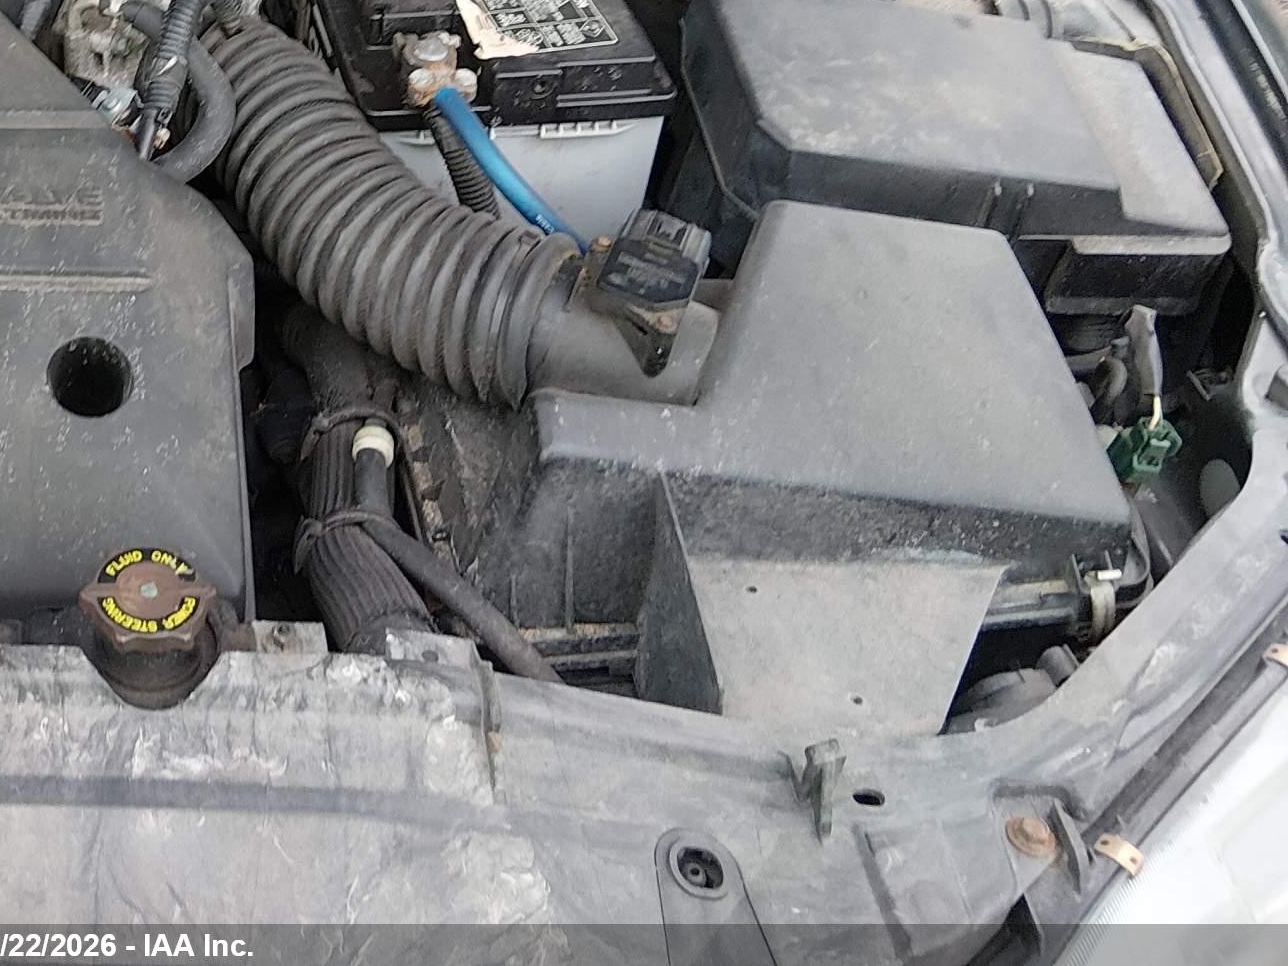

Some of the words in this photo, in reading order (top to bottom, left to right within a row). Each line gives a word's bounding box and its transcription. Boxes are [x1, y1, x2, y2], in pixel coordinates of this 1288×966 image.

[105, 550, 143, 577] FLUID
[151, 550, 194, 576] ONLY
[102, 597, 158, 633] STEERING
[162, 597, 197, 630] POWER
